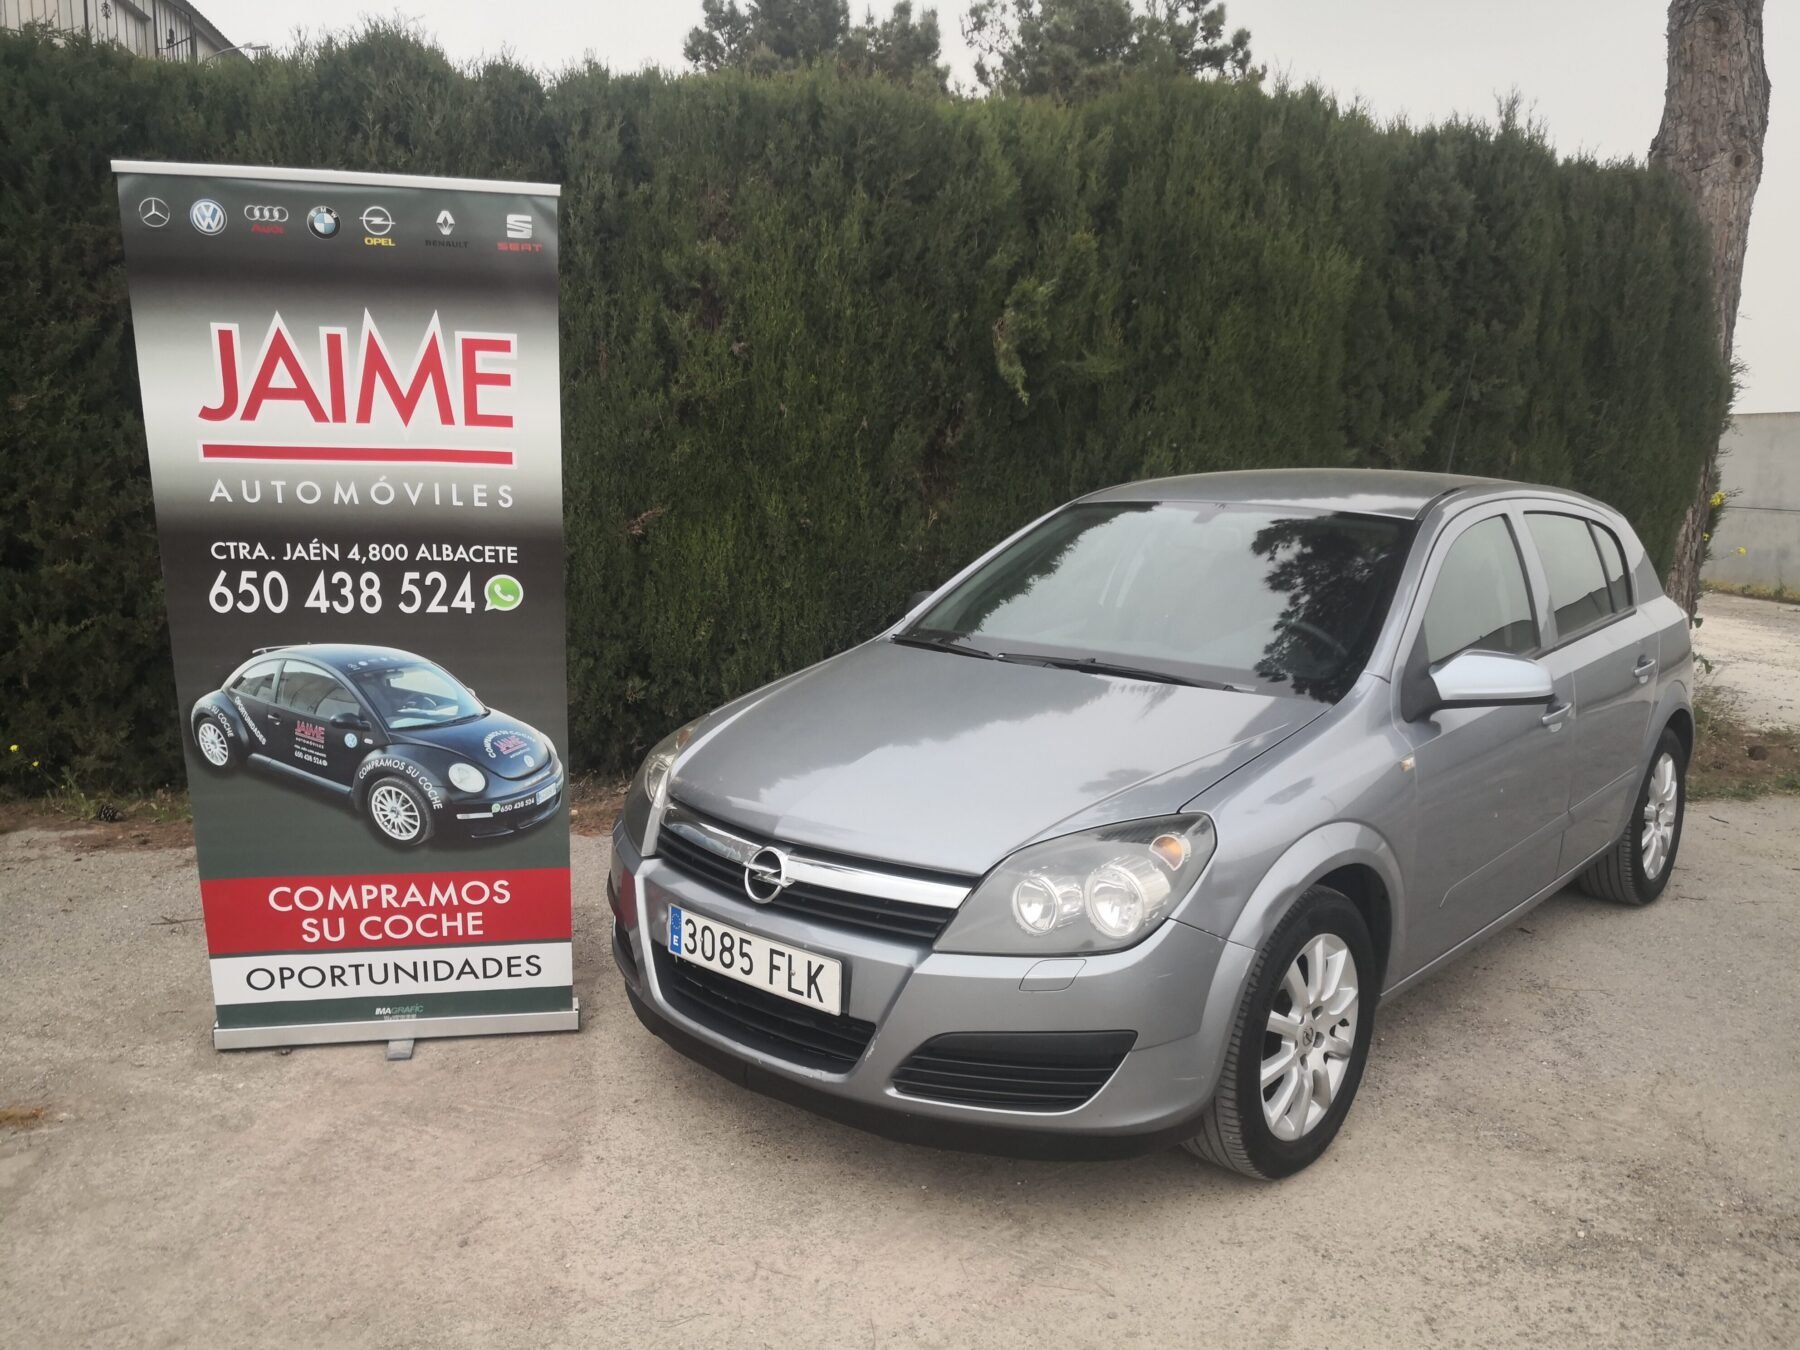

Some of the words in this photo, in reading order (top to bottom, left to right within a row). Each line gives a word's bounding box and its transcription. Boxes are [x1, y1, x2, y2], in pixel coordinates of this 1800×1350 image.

[310, 206, 338, 220] BMW
[364, 236, 396, 247] OPEL
[425, 240, 469, 249] RENAULT
[496, 242, 543, 252] SEAT
[198, 307, 518, 429] JAIME
[209, 475, 514, 508] AUTOMÓVILES
[210, 542, 275, 561] CTRA.
[283, 538, 339, 561] JAÉN
[347, 543, 408, 564] 4,800
[416, 543, 518, 564] ALBACETE
[209, 569, 289, 614] 650
[304, 569, 382, 614] 438
[398, 570, 475, 614] 524
[358, 758, 406, 779] COMPRAMOS
[406, 765, 420, 778] SU
[418, 776, 443, 810] COCHE
[268, 879, 511, 913] COMPRAMOS
[301, 917, 345, 943] SU
[359, 911, 484, 941] COCHE
[672, 934, 680, 947] E
[246, 954, 542, 991] OPORTUNIDADES
[684, 918, 754, 976] 3085
[769, 948, 825, 1003] FLK
